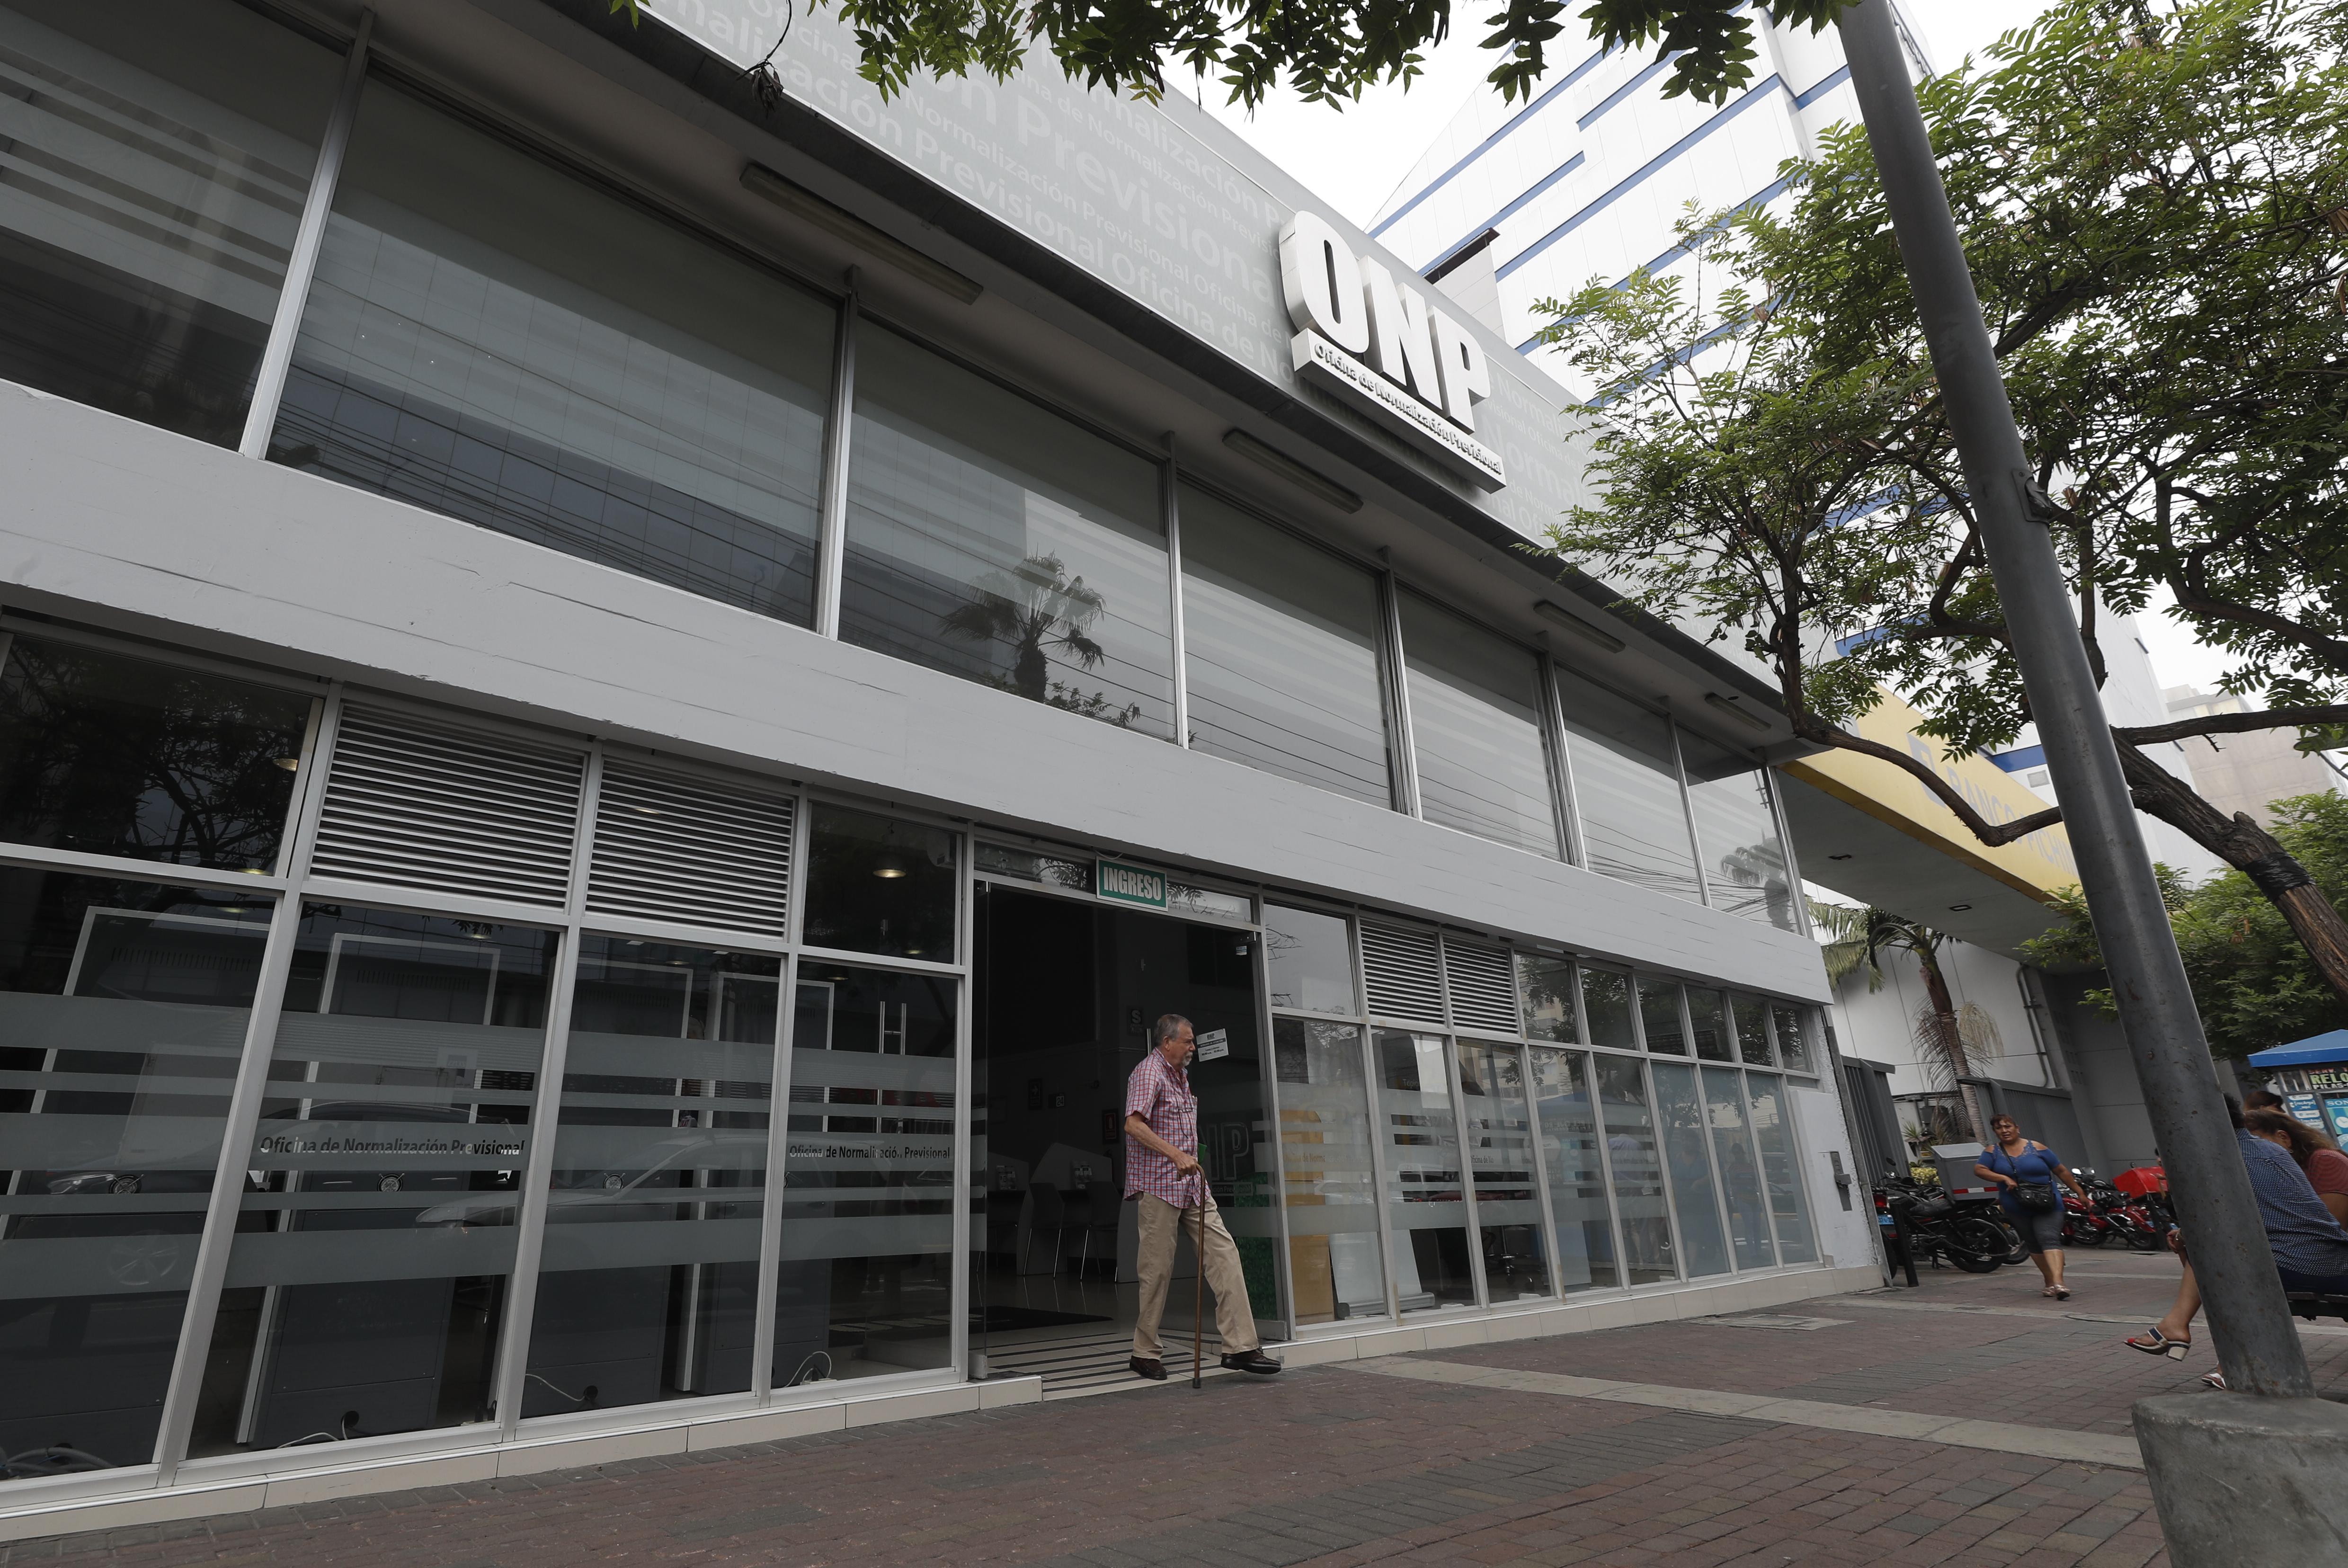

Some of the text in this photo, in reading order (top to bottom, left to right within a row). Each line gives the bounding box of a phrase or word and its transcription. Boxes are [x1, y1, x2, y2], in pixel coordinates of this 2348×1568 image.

[906, 87, 1077, 214] Normalización
[1083, 200, 1189, 284] Previsional
[1194, 274, 1257, 328] Oficina
[1261, 319, 1281, 343] de
[916, 127, 1254, 360] Previsional Oficina de
[1018, 94, 1287, 315] Previsional
[1058, 97, 1083, 124] de
[1088, 113, 1218, 219] Normalización
[1221, 207, 1281, 262] Previsio
[1280, 211, 1491, 434] ONP
[1314, 342, 1358, 382] Oficina
[1359, 372, 1375, 392] de
[1375, 381, 1450, 446] Normalización
[1449, 429, 1503, 475] Previsional
[1509, 479, 1523, 498] de
[1103, 866, 1162, 901] INGRESO
[261, 1137, 525, 1156] Oficina de Normalización Previsional
[789, 1145, 950, 1159] Oficina de Normaliació Previsional
